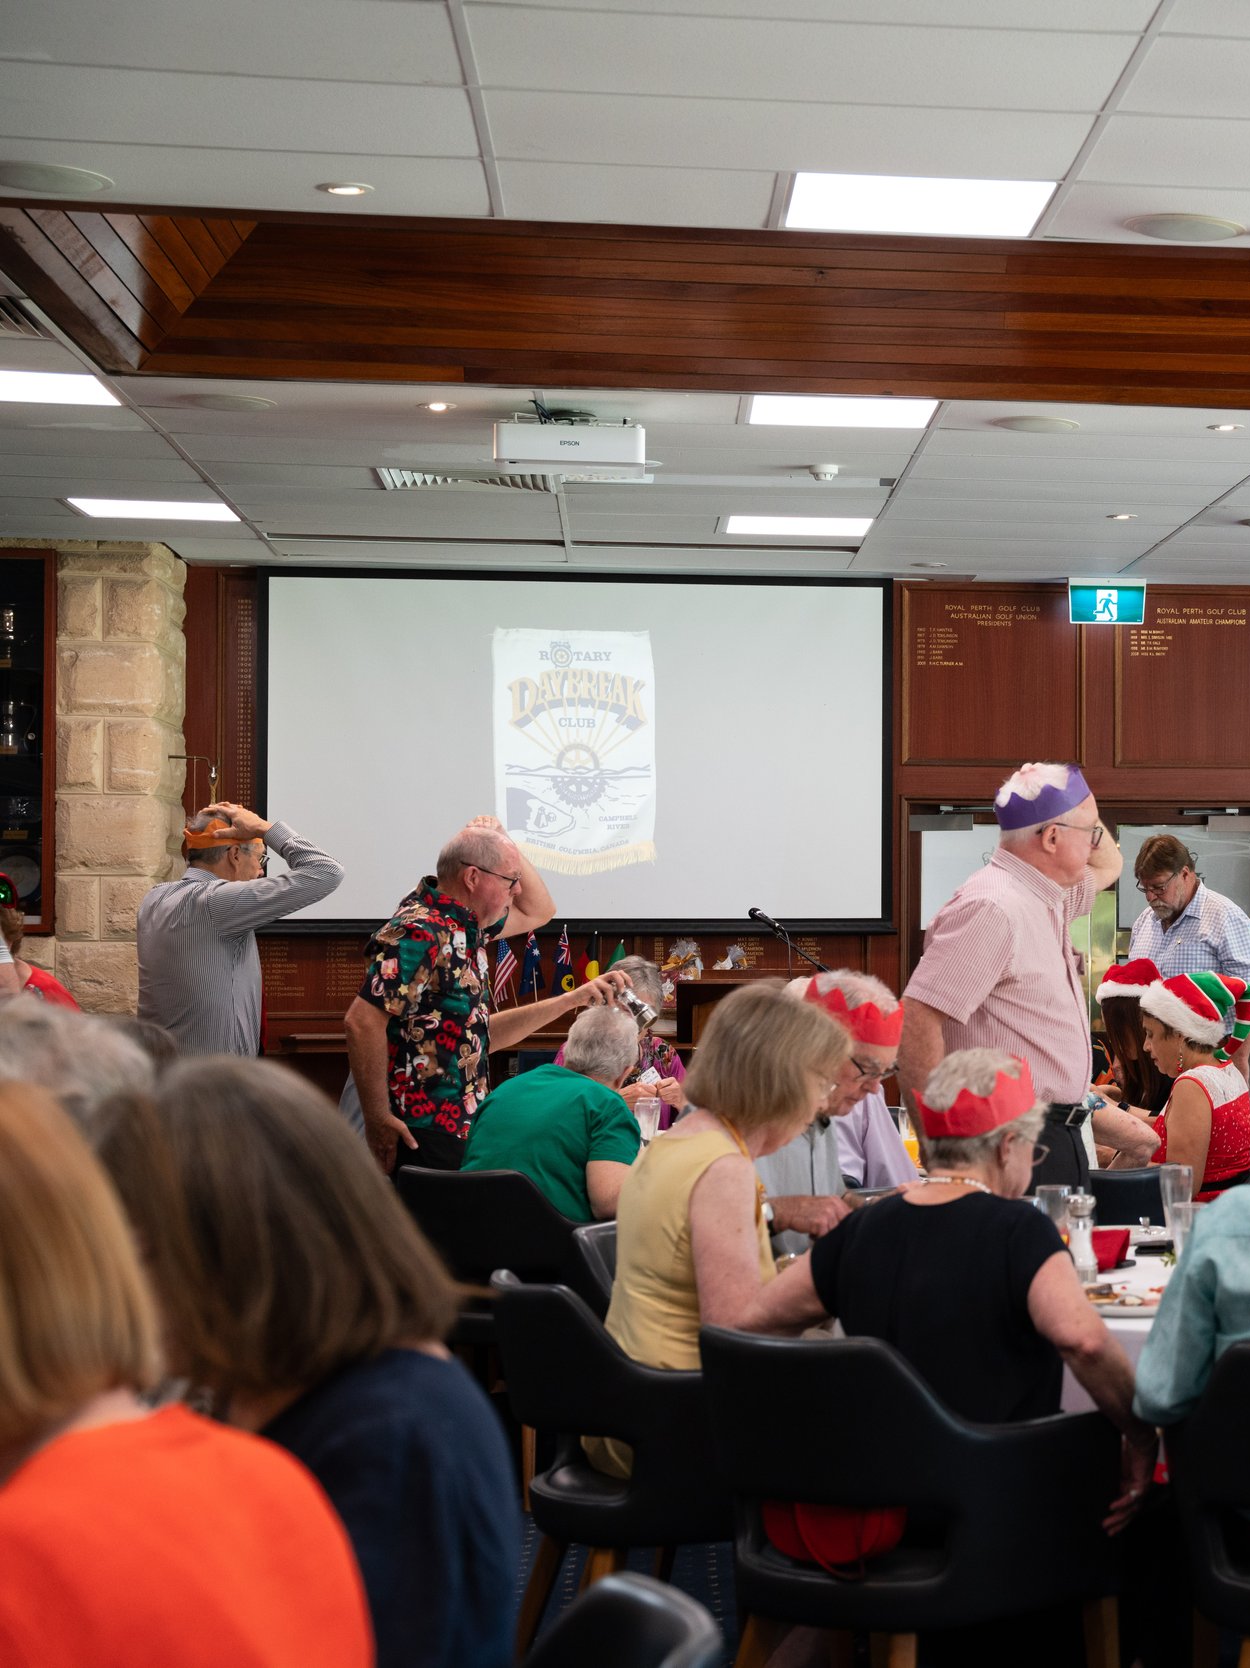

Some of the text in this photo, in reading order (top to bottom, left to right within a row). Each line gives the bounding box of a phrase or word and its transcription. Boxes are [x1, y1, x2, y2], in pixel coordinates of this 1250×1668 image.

[508, 668, 647, 730] DAYBREAK
[558, 717, 596, 728] CLUB
[526, 837, 556, 850] BRITISH
[600, 840, 630, 852] CANADA
